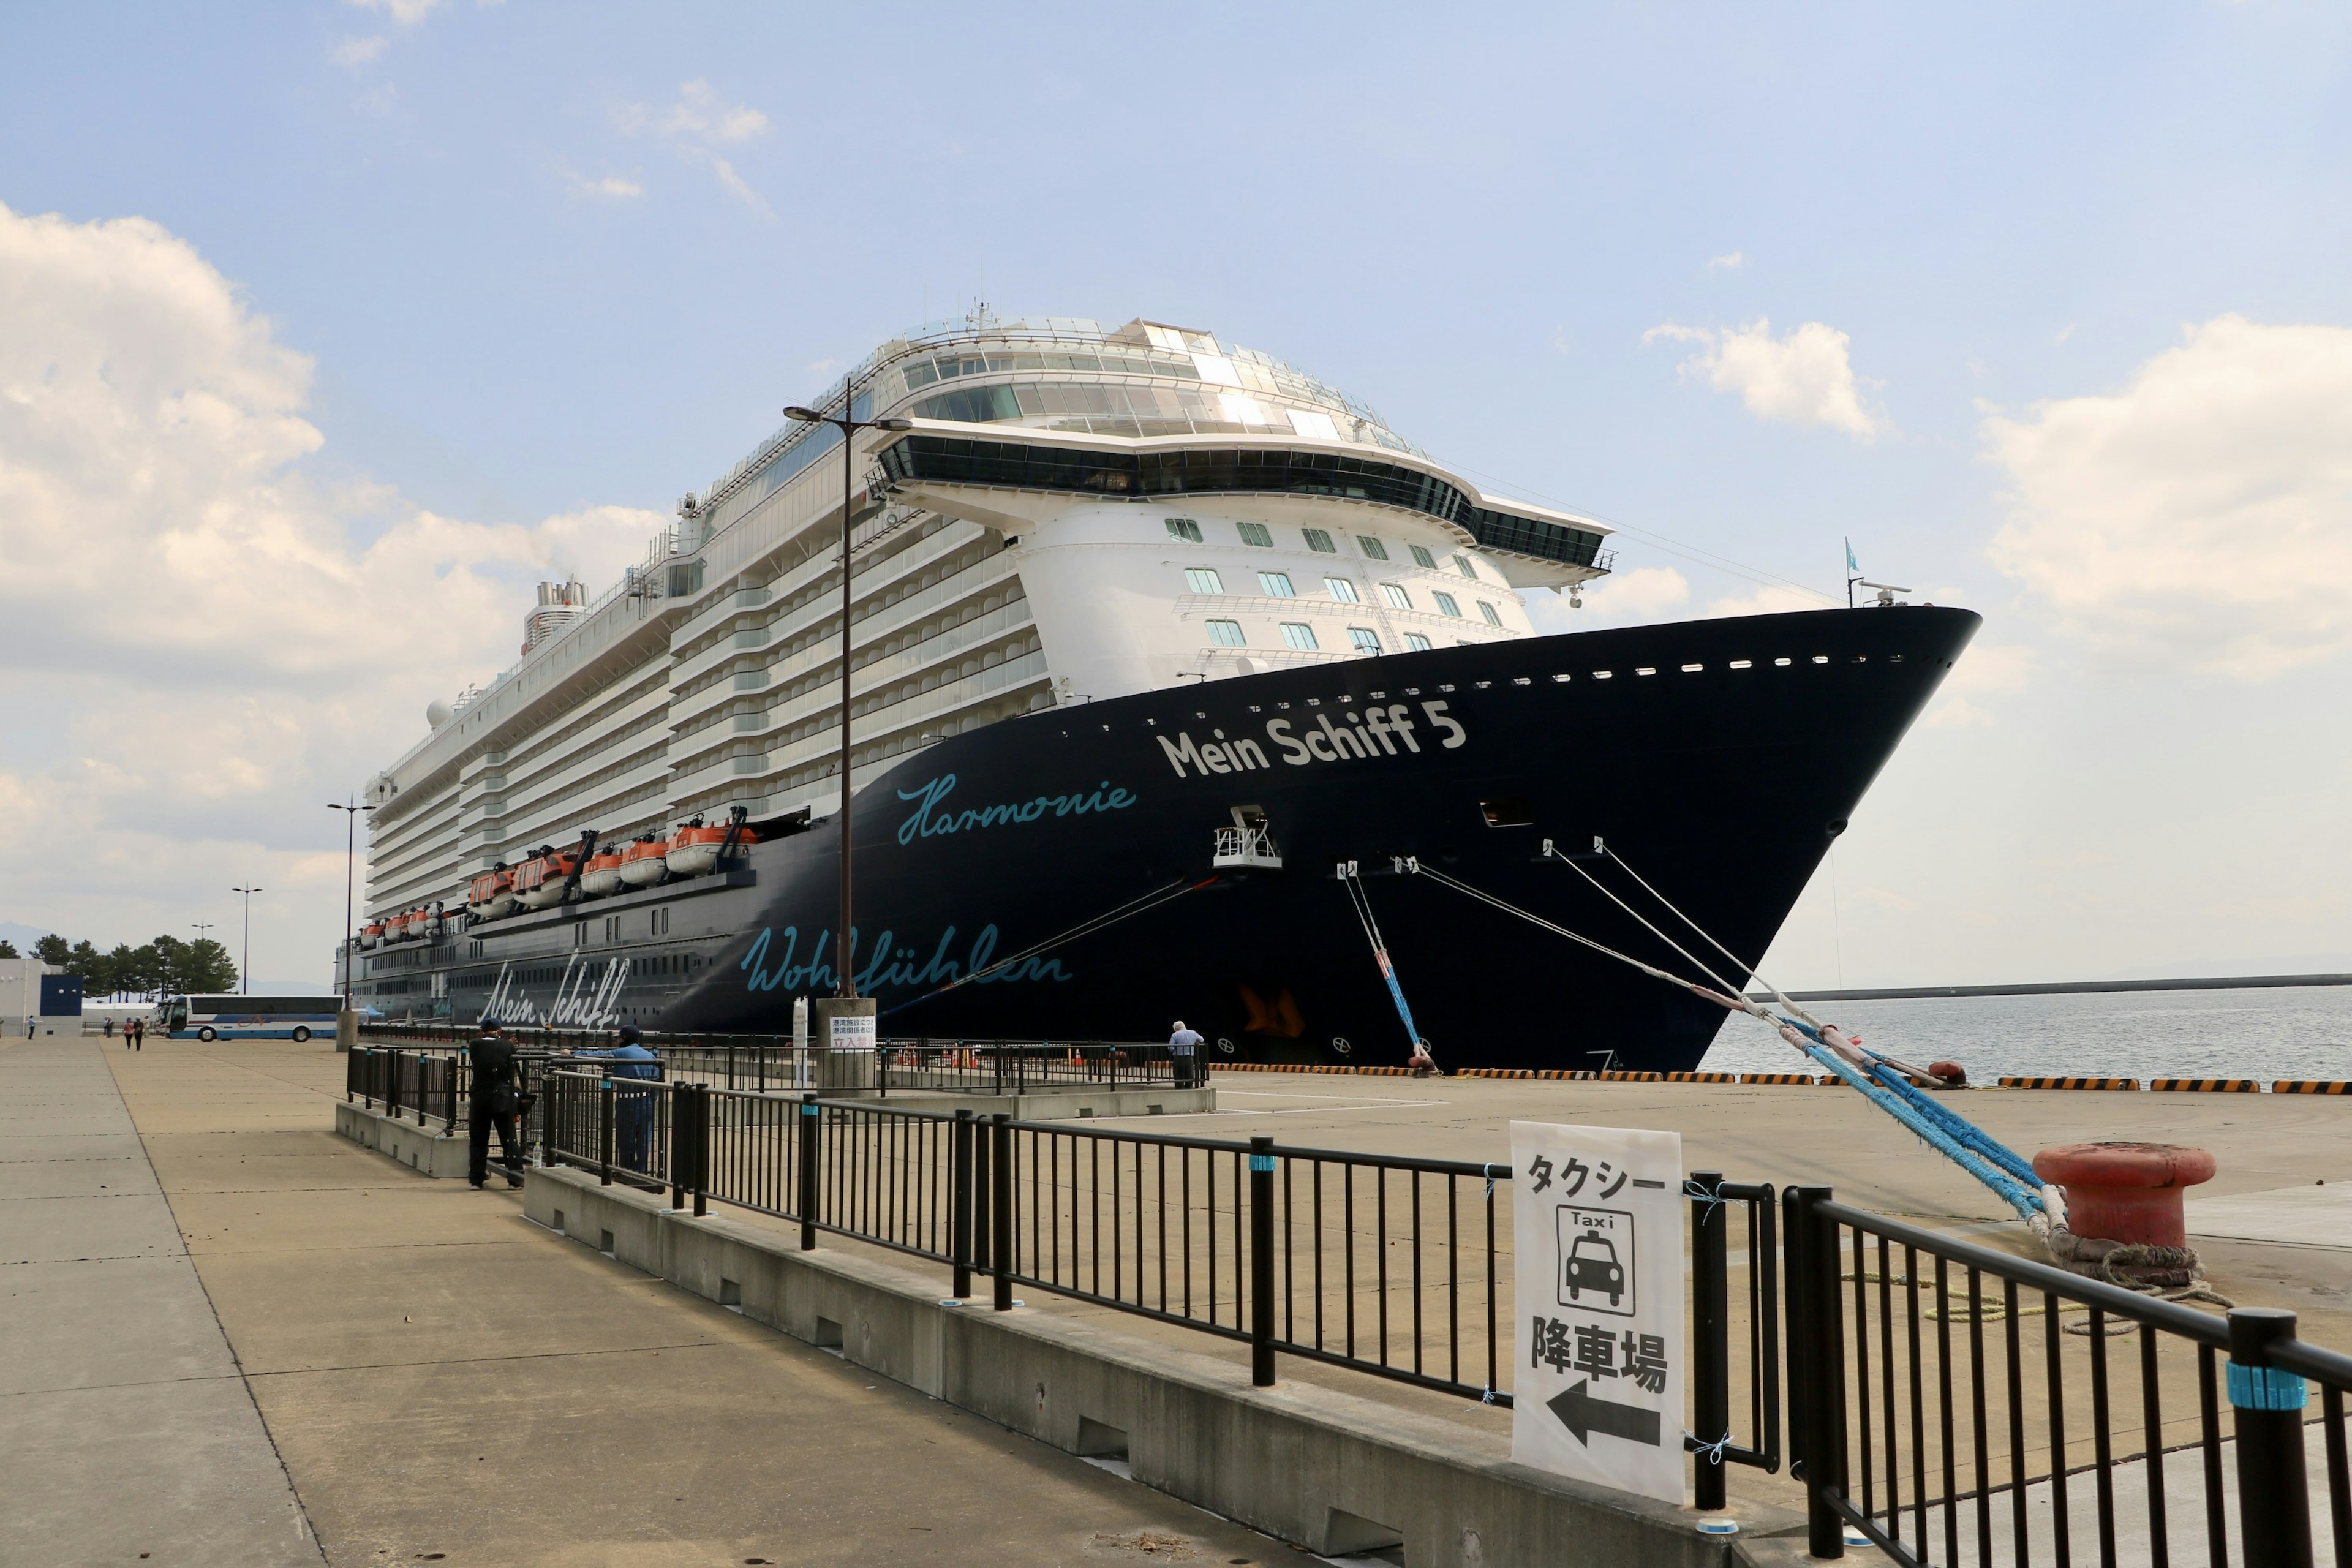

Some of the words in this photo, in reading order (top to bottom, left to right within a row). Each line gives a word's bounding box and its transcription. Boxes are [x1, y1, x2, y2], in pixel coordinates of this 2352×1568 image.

[1156, 729, 1270, 778] Mein
[1265, 704, 1420, 766] Schiff
[1420, 700, 1466, 749] 5
[897, 773, 1137, 846] Harmonie
[477, 960, 536, 1023] Mein
[834, 1036, 873, 1048] 立入禁止
[1528, 1155, 1665, 1200] タクシー
[1571, 1212, 1613, 1229] Taxi
[1532, 1316, 1667, 1394] 降車場
